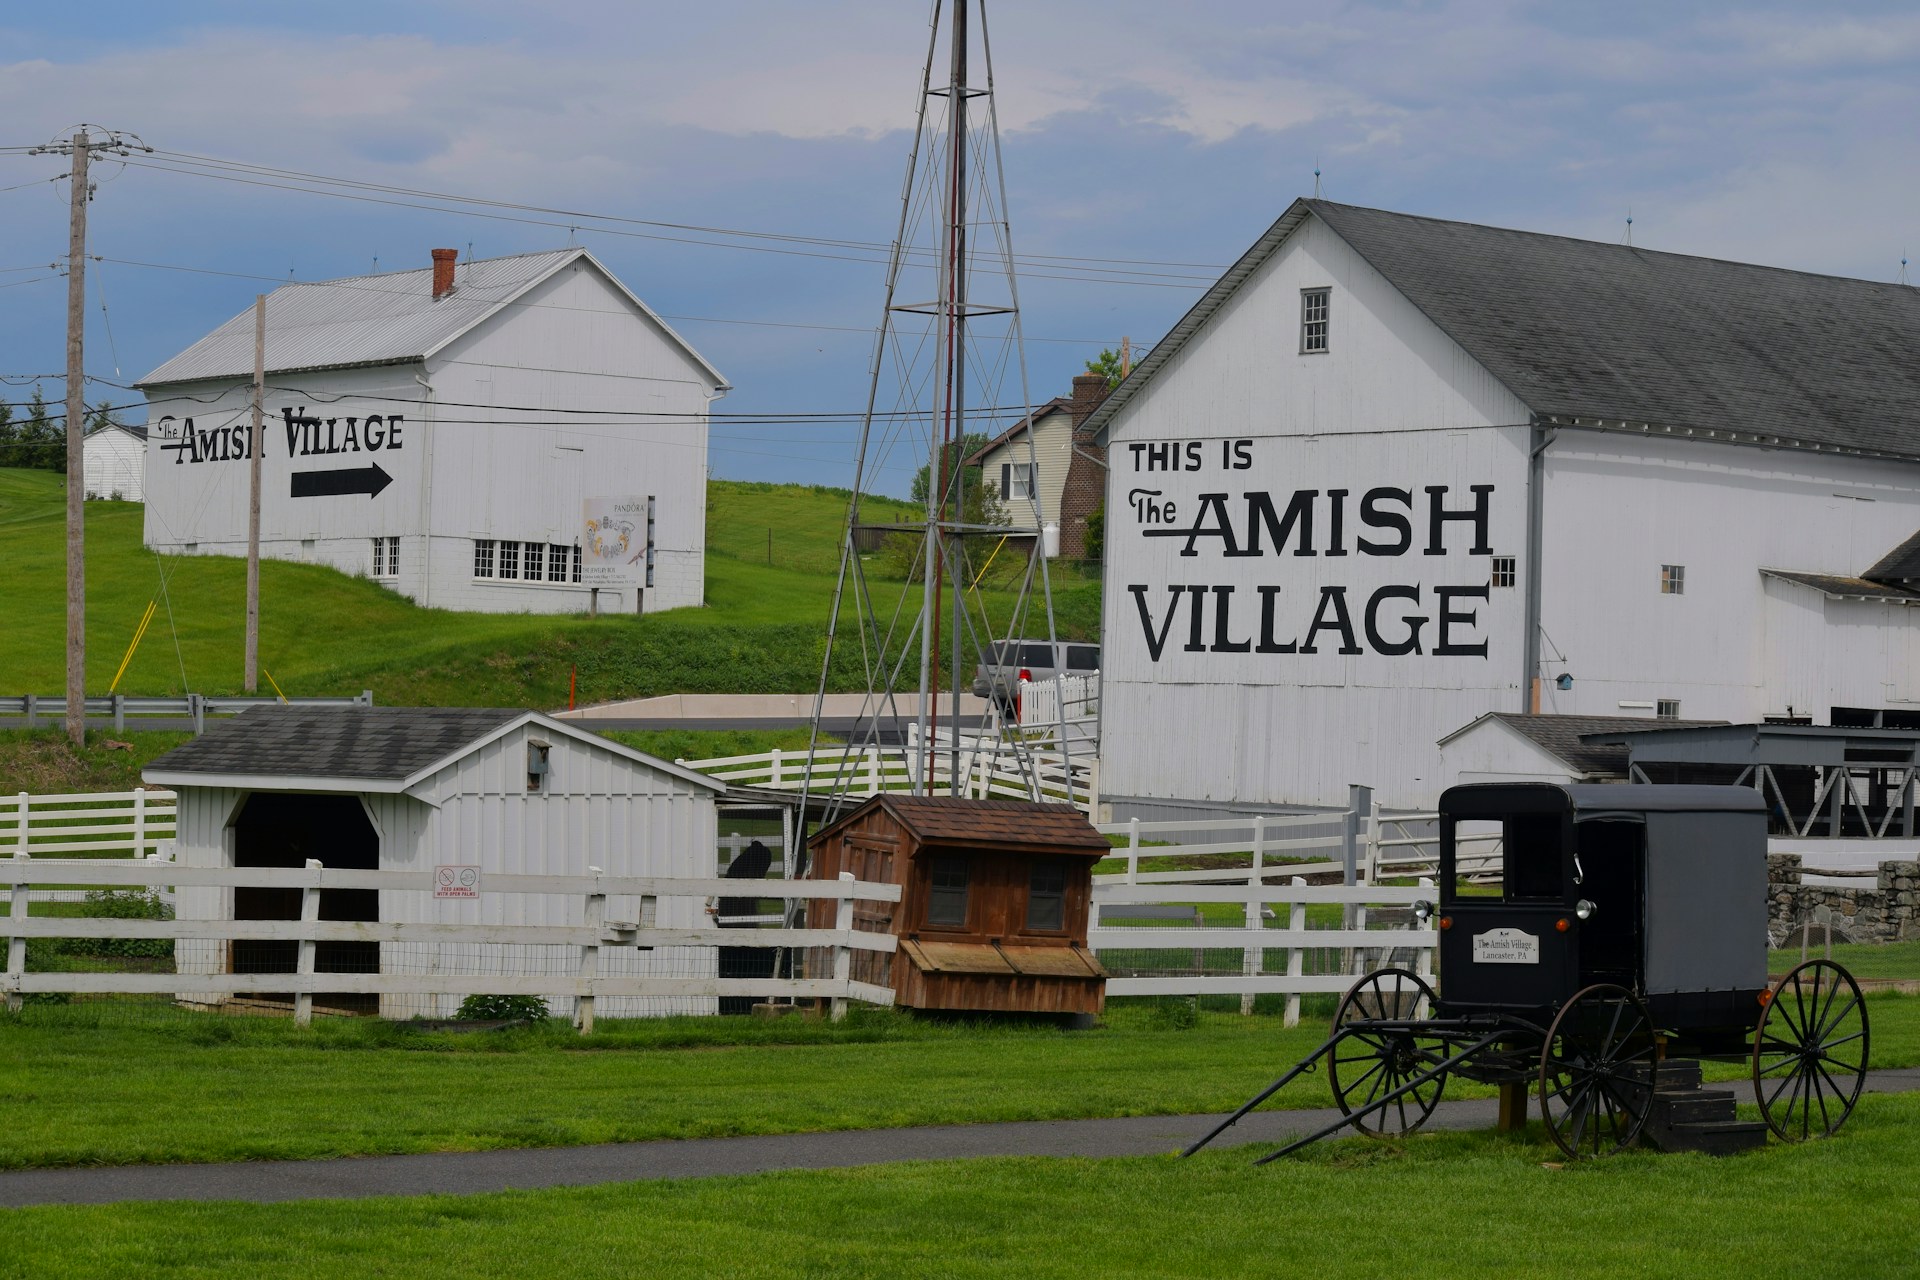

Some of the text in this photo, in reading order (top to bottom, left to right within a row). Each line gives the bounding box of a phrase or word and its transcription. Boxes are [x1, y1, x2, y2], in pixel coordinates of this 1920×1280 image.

[158, 415, 178, 439] The
[281, 406, 404, 458] VILLAGE
[1128, 439, 1253, 472] THIS IS
[1128, 484, 1495, 558] The AMISH
[1127, 580, 1490, 662] VILLAGE
[1478, 939, 1532, 951] The Amish Village
[1482, 951, 1527, 960] Lancaster, PA
